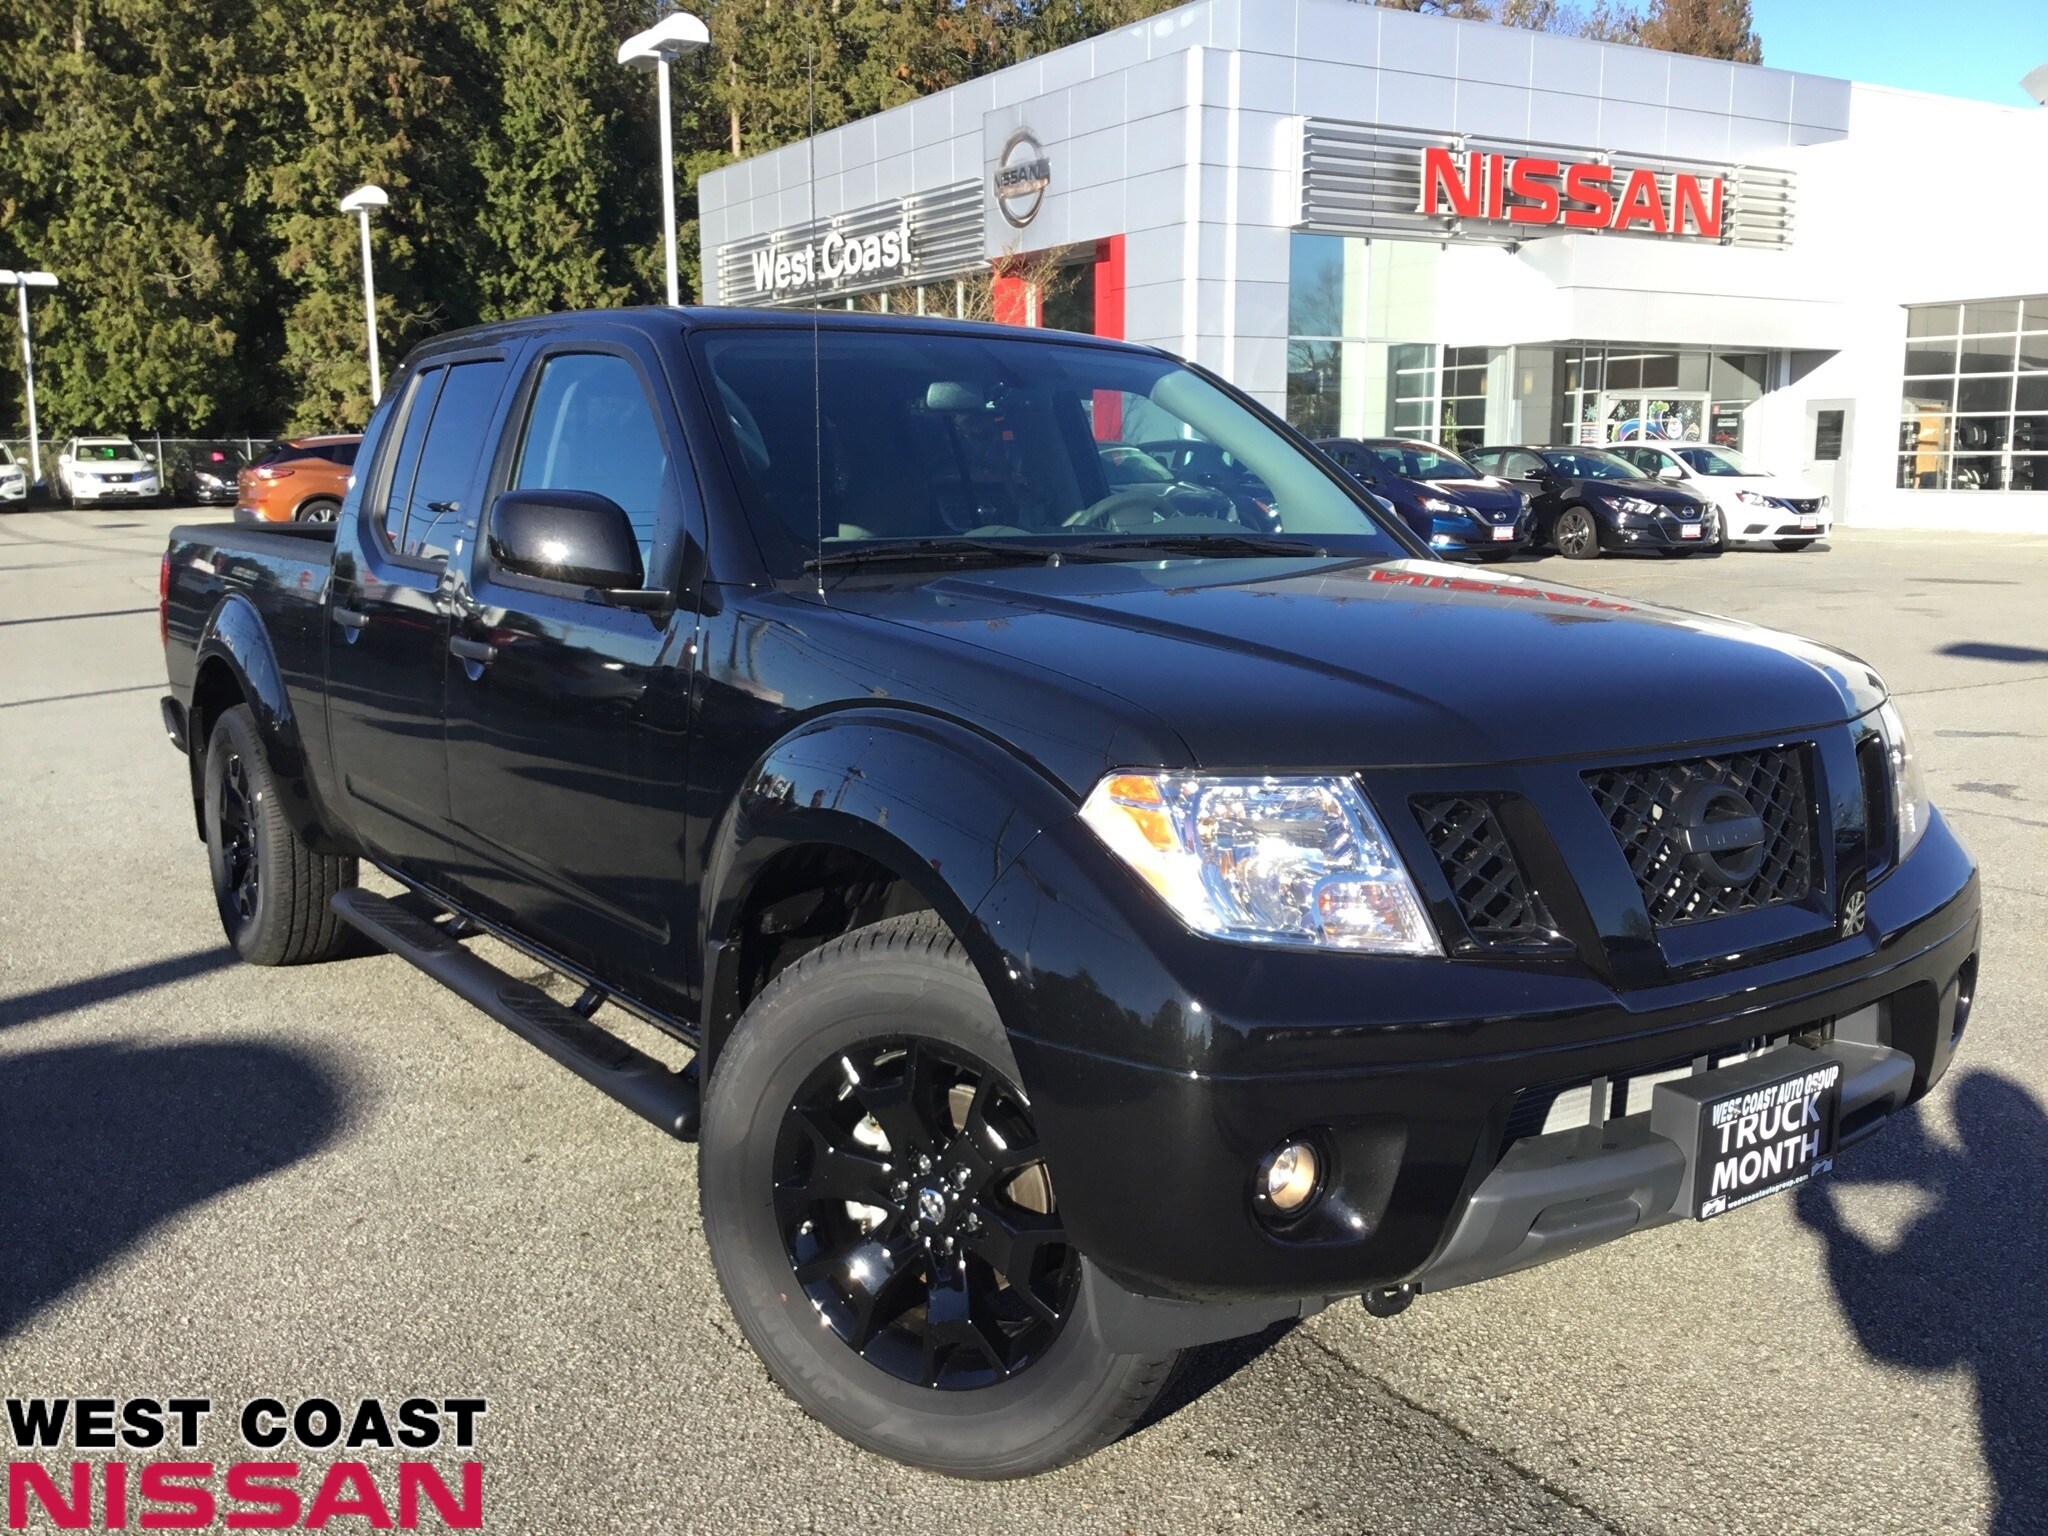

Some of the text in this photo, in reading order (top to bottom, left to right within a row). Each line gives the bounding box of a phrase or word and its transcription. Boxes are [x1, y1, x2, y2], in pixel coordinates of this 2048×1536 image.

[1419, 147, 1724, 238] NISSAN
[752, 217, 912, 292] West Coast
[1712, 1065, 1839, 1127] WEST COAST AUTO GROUP
[1717, 1091, 1823, 1154] TRUCK
[1711, 1129, 1820, 1196] MONTH
